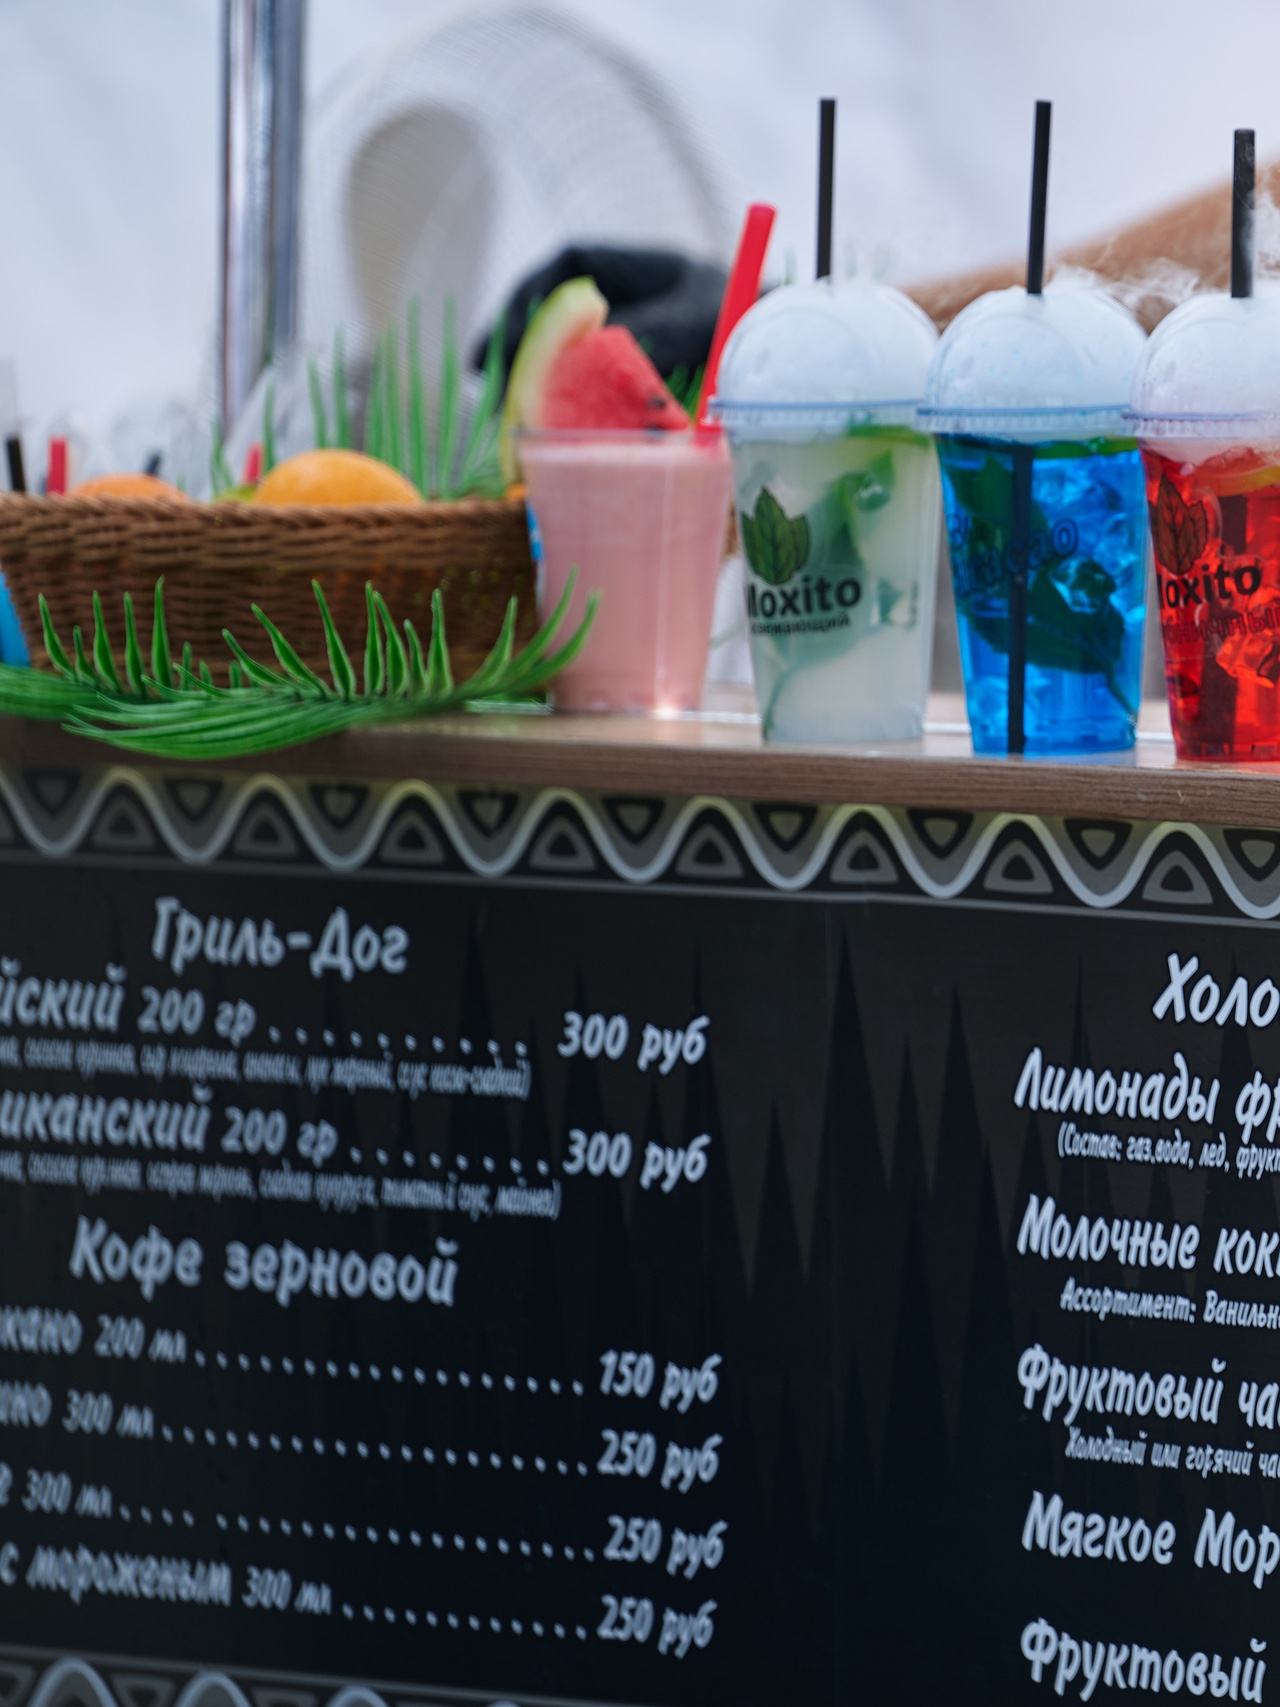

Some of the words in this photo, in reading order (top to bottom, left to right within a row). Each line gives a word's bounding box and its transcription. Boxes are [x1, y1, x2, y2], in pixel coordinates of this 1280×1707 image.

[153, 899, 407, 978] Гриль-Дог
[139, 988, 203, 1031] 200
[216, 1003, 254, 1042] гр
[558, 1011, 628, 1059] 300
[637, 1015, 709, 1074] руб
[1014, 1047, 1220, 1124] Лимонады
[223, 1109, 285, 1152] 200
[299, 1123, 336, 1163] гр
[563, 1130, 631, 1176] 300
[640, 1134, 710, 1192] руб
[1058, 1122, 1122, 1160] (Состав:
[1198, 1132, 1230, 1172] лед,
[71, 1219, 201, 1297] Кофе
[226, 1239, 456, 1305] зерновой
[1017, 1194, 1200, 1269] Молочные
[1060, 1277, 1197, 1323] Ассортимент:
[95, 1316, 144, 1357] 200
[601, 1351, 654, 1396] 150
[660, 1354, 722, 1412] руб
[1017, 1343, 1226, 1426] Фруктовый
[64, 1391, 112, 1433] 300
[598, 1430, 655, 1476] 250
[661, 1434, 722, 1491] руб
[1064, 1425, 1148, 1466] Холодный
[1150, 1442, 1181, 1469] или
[24, 1470, 71, 1512] 300
[604, 1516, 661, 1562] 250
[667, 1521, 727, 1577] руб
[1022, 1491, 1176, 1565] Мягкое
[27, 1547, 231, 1605] мороженым
[243, 1567, 291, 1609] 300
[598, 1595, 652, 1641] 250
[659, 1600, 717, 1657] руб
[1021, 1618, 1267, 1704] Фруктовый
